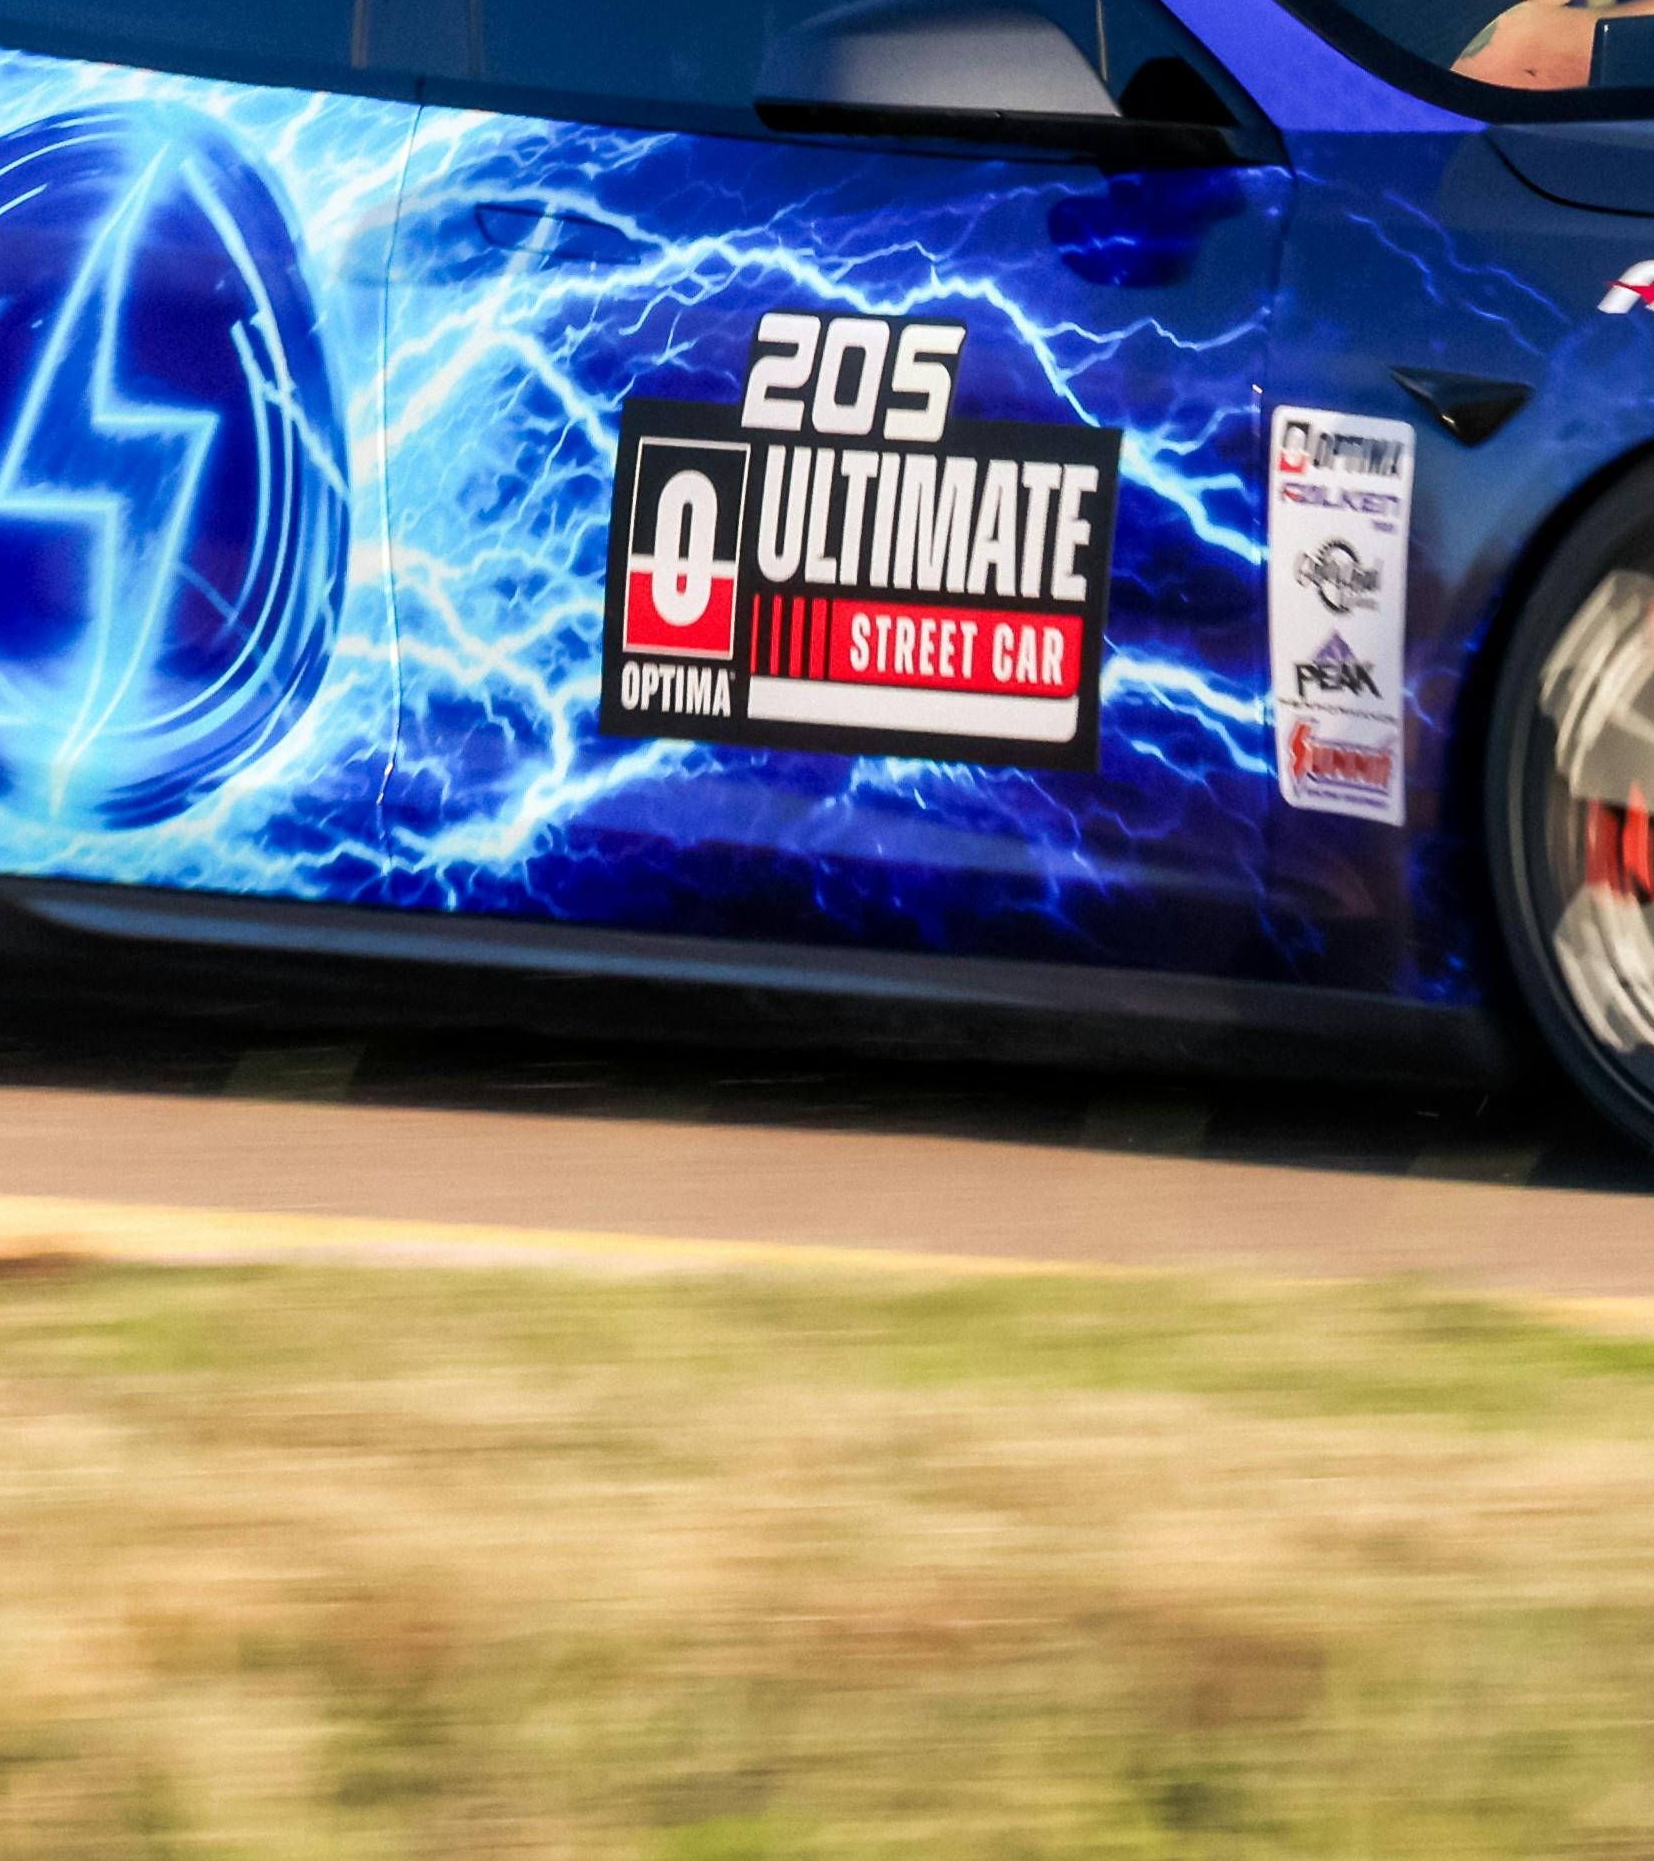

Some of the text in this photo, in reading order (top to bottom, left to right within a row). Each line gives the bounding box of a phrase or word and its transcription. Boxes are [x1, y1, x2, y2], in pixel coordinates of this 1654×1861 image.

[741, 312, 967, 443] 205
[757, 444, 1099, 602] ULTIMATE
[621, 660, 732, 718] OPTIMA
[849, 613, 1065, 687] STREET CAR
